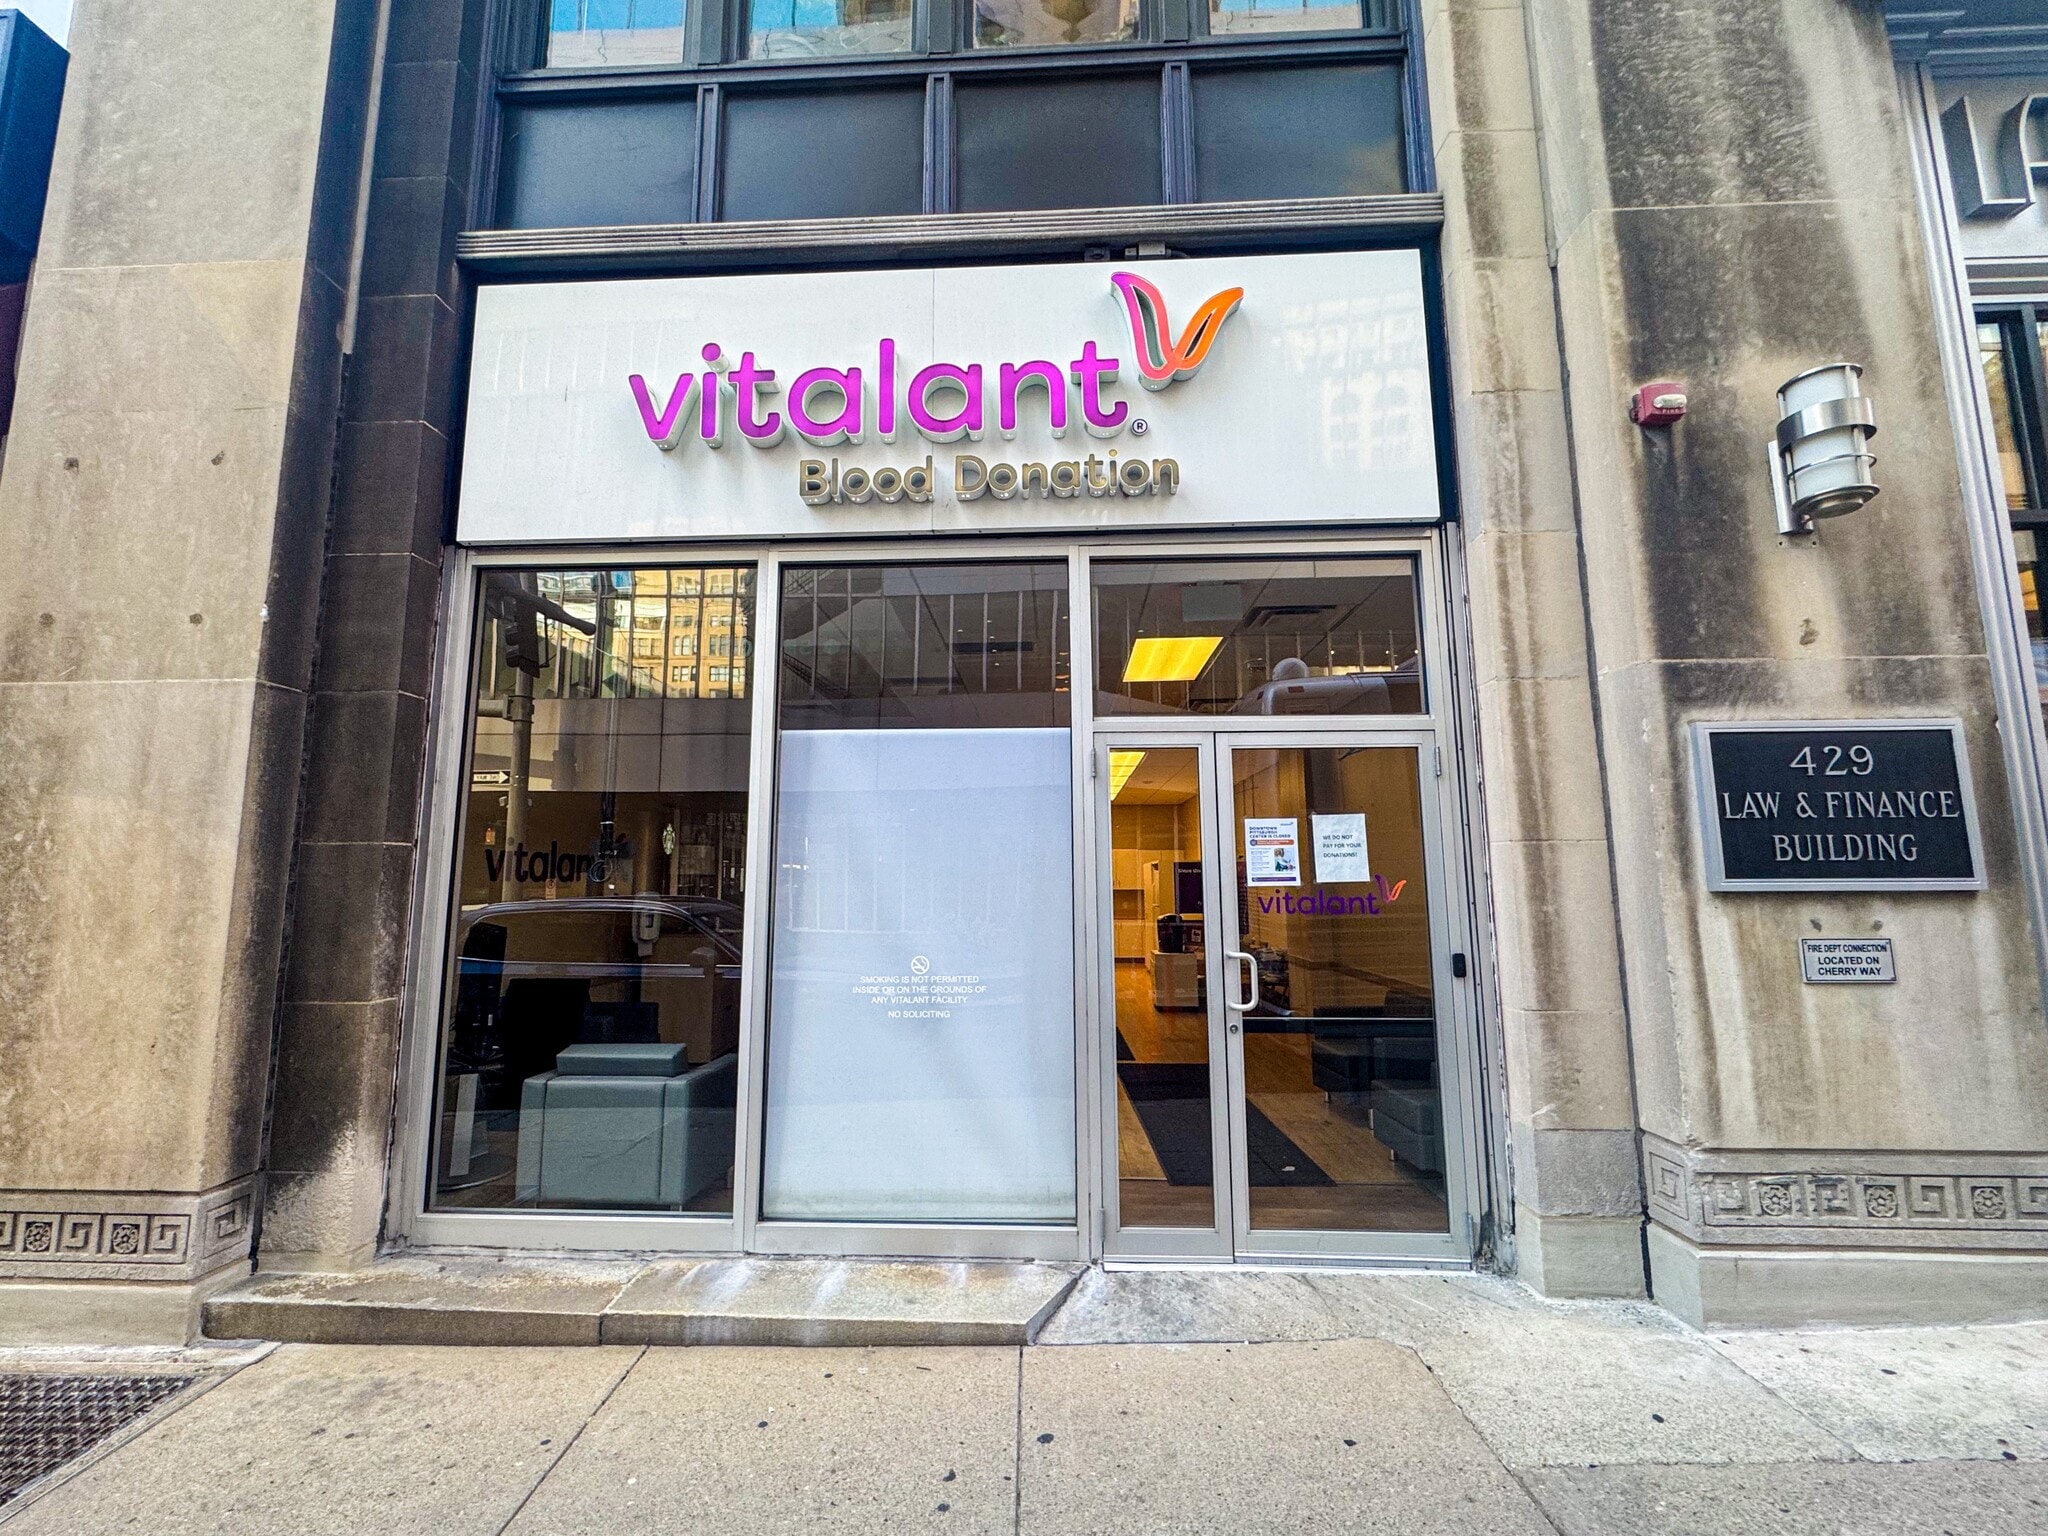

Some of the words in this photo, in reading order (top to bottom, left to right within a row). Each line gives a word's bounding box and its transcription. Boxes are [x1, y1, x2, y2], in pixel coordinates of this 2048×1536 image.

[628, 338, 1130, 447] vitalant
[799, 455, 934, 503] Blood
[955, 448, 1181, 501] Donation
[1790, 745, 1874, 777] 429
[1722, 791, 1781, 819] LAW
[1796, 792, 1817, 818] &
[1827, 791, 1960, 818] FINANCE
[1773, 834, 1918, 861] BUILDING
[485, 840, 604, 882] vitalan
[1257, 889, 1381, 916] vitalant
[1807, 944, 1822, 953] FIRE
[1824, 944, 1841, 953] DEPT
[1842, 944, 1887, 953] CONNECTION
[1818, 956, 1863, 965] LOCATED
[1865, 956, 1880, 965] ON
[860, 975, 899, 984] SMOKING
[901, 975, 909, 984] IS
[911, 975, 929, 984] NOT
[931, 975, 979, 984] PERMITTED
[1818, 967, 1857, 976] CHERRY
[1859, 967, 1881, 976] WAY
[852, 986, 880, 994] INSIDE
[882, 986, 895, 994] OR
[896, 985, 910, 994] ON
[911, 985, 928, 994] THE
[930, 985, 973, 994] GROUNDS
[974, 985, 987, 994] OF
[871, 996, 888, 1004] ANY
[889, 996, 929, 1004] VITALANT
[931, 996, 968, 1004] FACILITY
[888, 1010, 901, 1018] NO
[902, 1010, 950, 1018] SOLICITING
